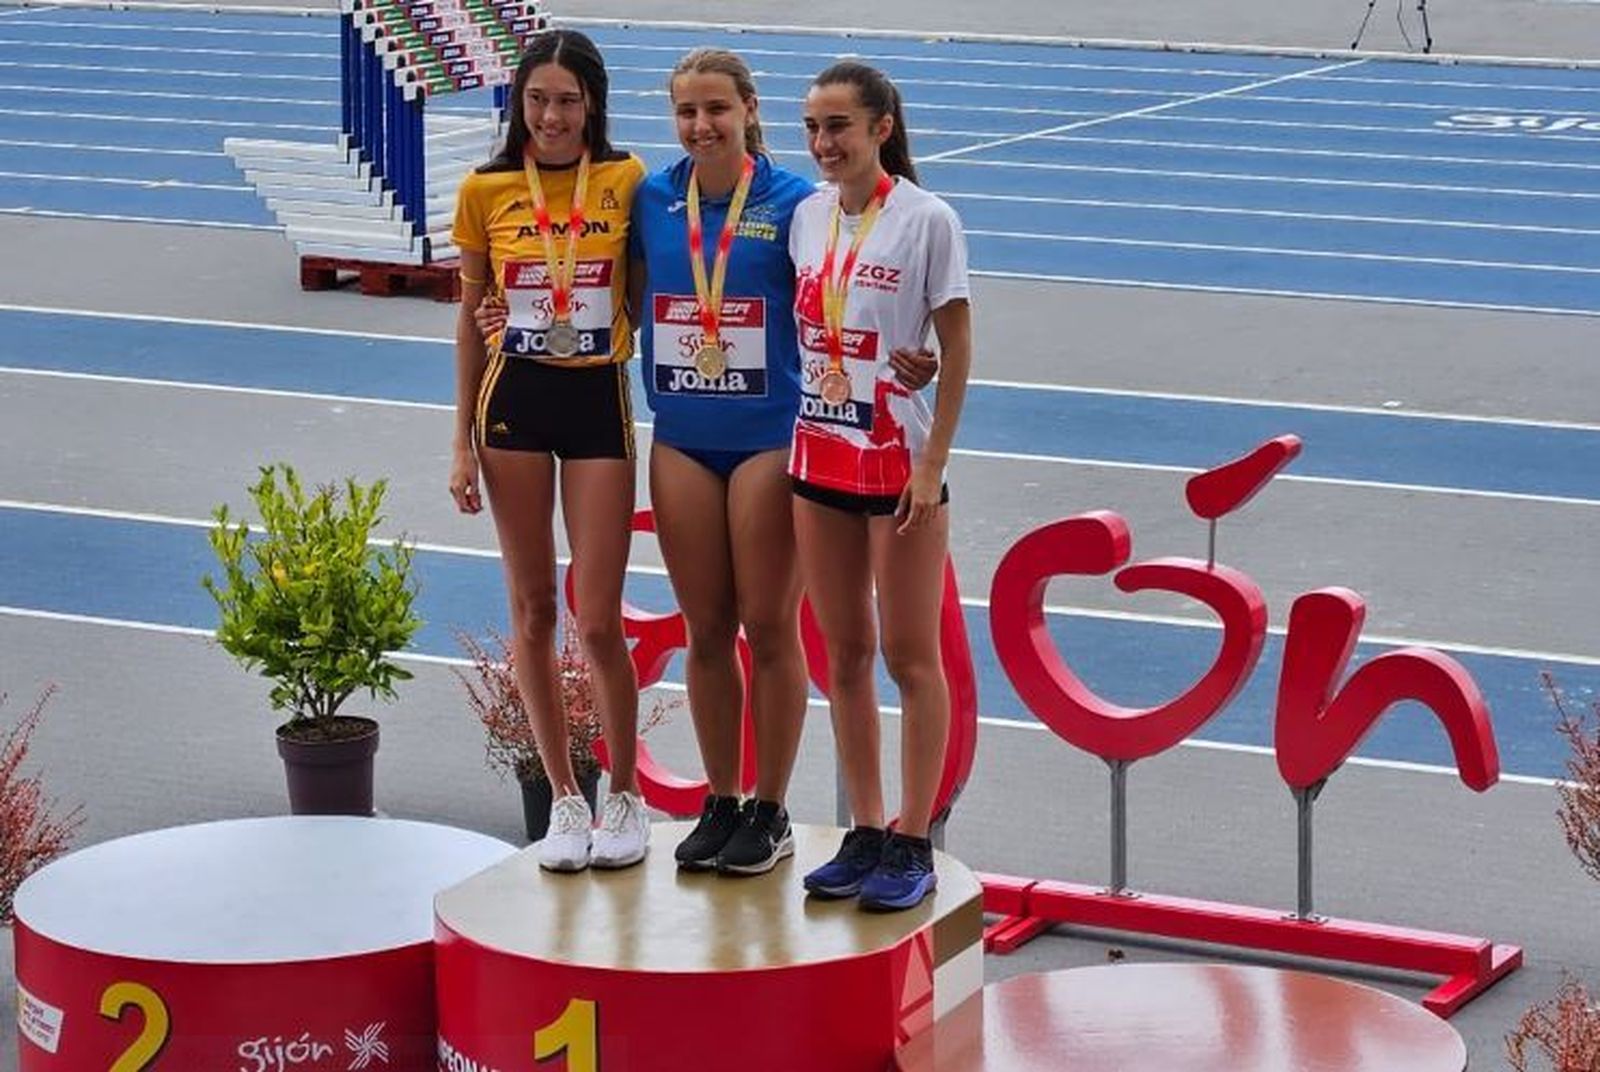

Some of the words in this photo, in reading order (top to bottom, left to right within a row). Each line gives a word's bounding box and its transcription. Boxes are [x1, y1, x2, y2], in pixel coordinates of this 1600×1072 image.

[857, 264, 902, 284] ZGZ
[516, 330, 596, 353] Joa
[799, 395, 860, 424] oma
[99, 981, 172, 1072] 2
[533, 997, 601, 1072] 1
[237, 1031, 334, 1072] gijón
